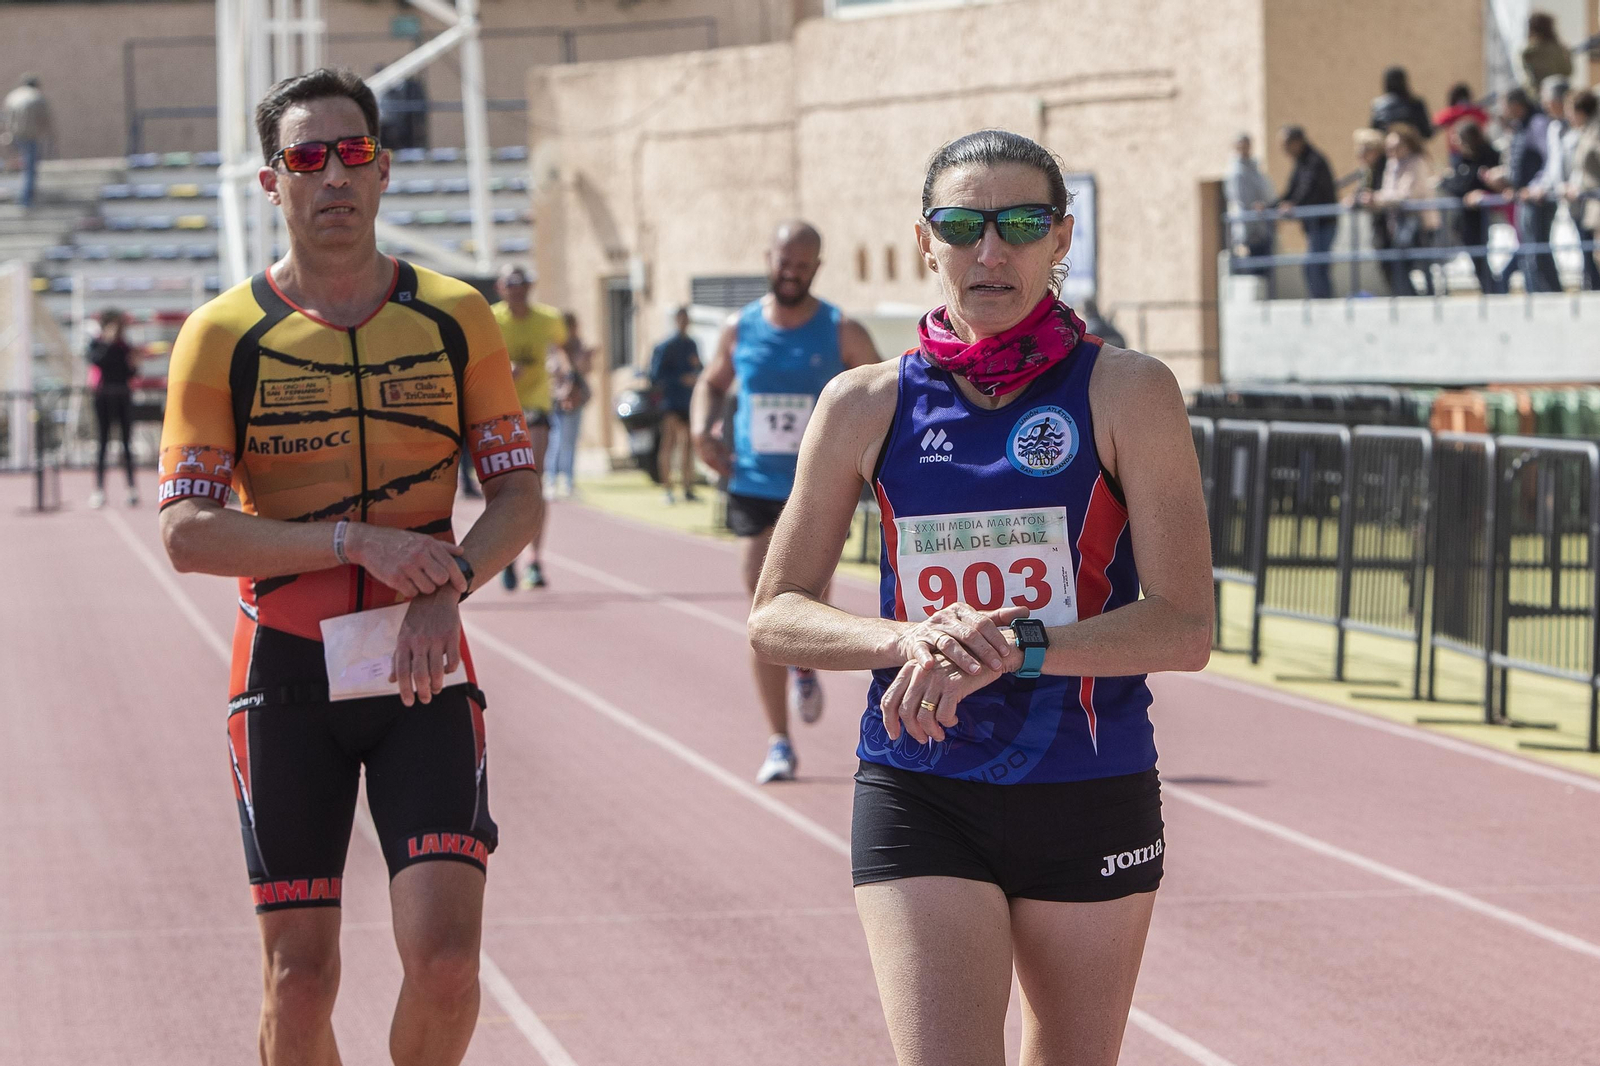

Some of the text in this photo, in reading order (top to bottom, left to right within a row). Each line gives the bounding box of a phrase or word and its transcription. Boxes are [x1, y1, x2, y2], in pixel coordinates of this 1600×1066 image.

[768, 412, 796, 432] 12
[919, 453, 953, 464] mobel
[914, 522, 945, 534] XXXIII
[949, 520, 983, 531] MEDIA
[914, 529, 1048, 553] BAHÍA DE CÁDIZ
[917, 557, 1053, 618] 903
